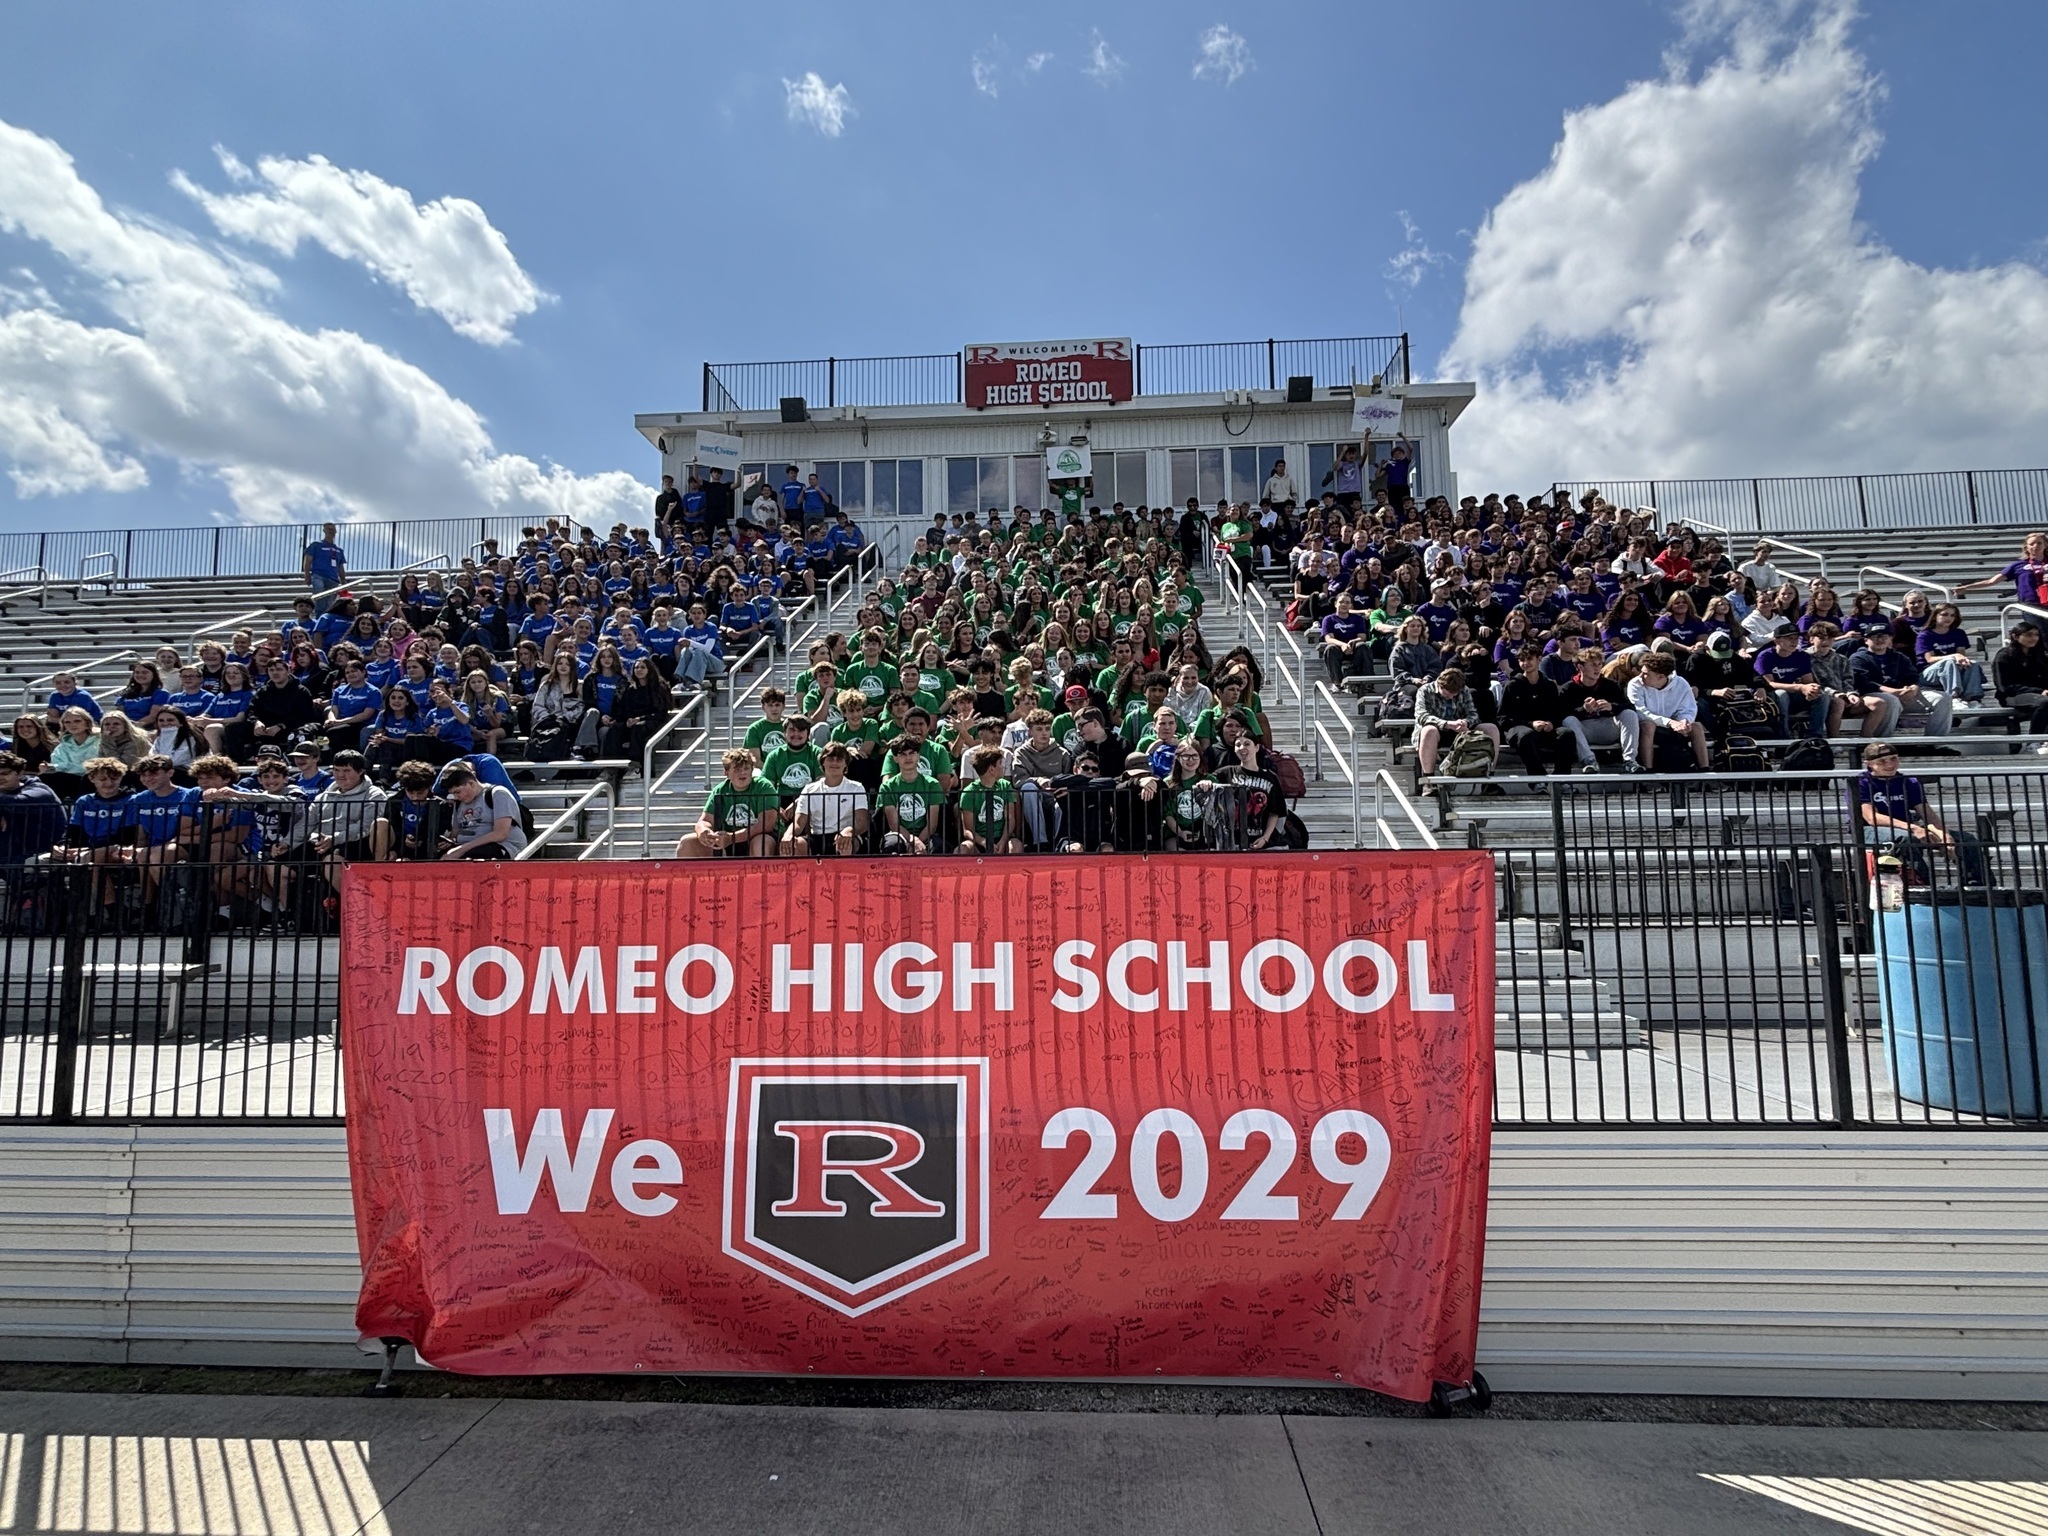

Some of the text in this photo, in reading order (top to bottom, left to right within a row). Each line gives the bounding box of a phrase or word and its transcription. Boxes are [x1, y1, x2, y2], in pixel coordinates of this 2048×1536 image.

[968, 346, 1003, 364] R
[1009, 344, 1088, 355] WELCOME TO
[1093, 340, 1129, 360] R
[1016, 361, 1082, 382] ROMEO
[986, 381, 1112, 404] HIGH SCHOOL
[1381, 874, 1413, 896] Tom
[861, 915, 912, 941] EASTON
[398, 944, 733, 1015] ROMEO
[772, 942, 1013, 1013] HIGH
[1051, 939, 1454, 1013] SCHOOL
[356, 1023, 425, 1062] Julia
[799, 1015, 878, 1048] Tiffany
[960, 1029, 997, 1048] Avery
[1039, 1028, 1085, 1055] Elise
[503, 1035, 569, 1057] Devon
[992, 1040, 1036, 1060] Chapman
[371, 1062, 465, 1086] Kaczor
[510, 1060, 553, 1079] Smith
[1167, 1069, 1215, 1100] Kyle
[1216, 1071, 1274, 1100] Thomas
[994, 1136, 1023, 1156] MAX
[484, 1109, 682, 1216] We
[771, 1120, 945, 1217] R
[994, 1157, 1030, 1173] Lee
[1041, 1108, 1391, 1221] 2029
[1013, 1225, 1076, 1249] Cooper
[1154, 1221, 1195, 1243] Evan
[574, 1237, 611, 1251] MAX
[1144, 1286, 1176, 1298] Kent
[1213, 1322, 1250, 1336] Kendall
